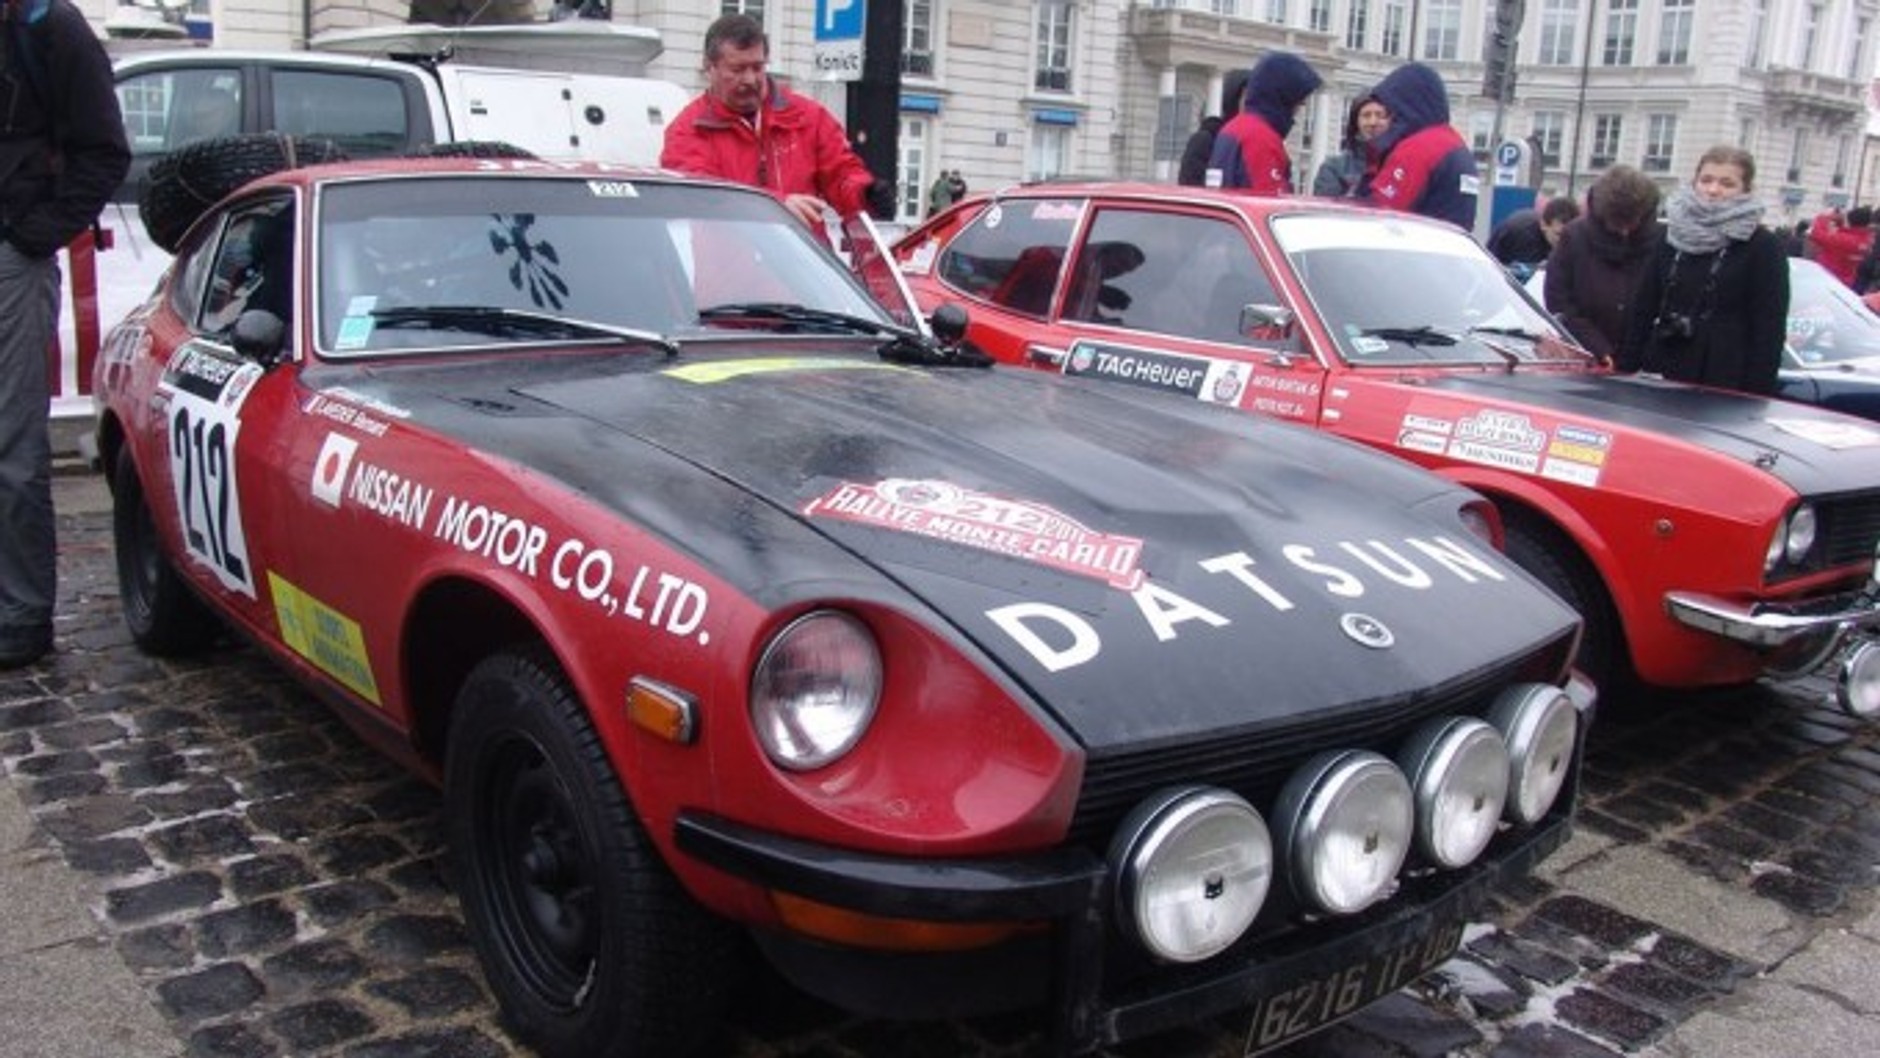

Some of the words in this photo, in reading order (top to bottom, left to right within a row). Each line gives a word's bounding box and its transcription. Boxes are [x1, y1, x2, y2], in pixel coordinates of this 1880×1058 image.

[174, 406, 248, 585] 212
[348, 461, 434, 530] NISSAN
[435, 496, 548, 577] MOTOR
[826, 485, 922, 522] RALLYE
[927, 515, 1023, 547] MONTE
[1029, 540, 1139, 576] CARLO
[957, 502, 1041, 528] 212
[985, 536, 1507, 673] DATSUN
[1259, 963, 1367, 1047] 6216
